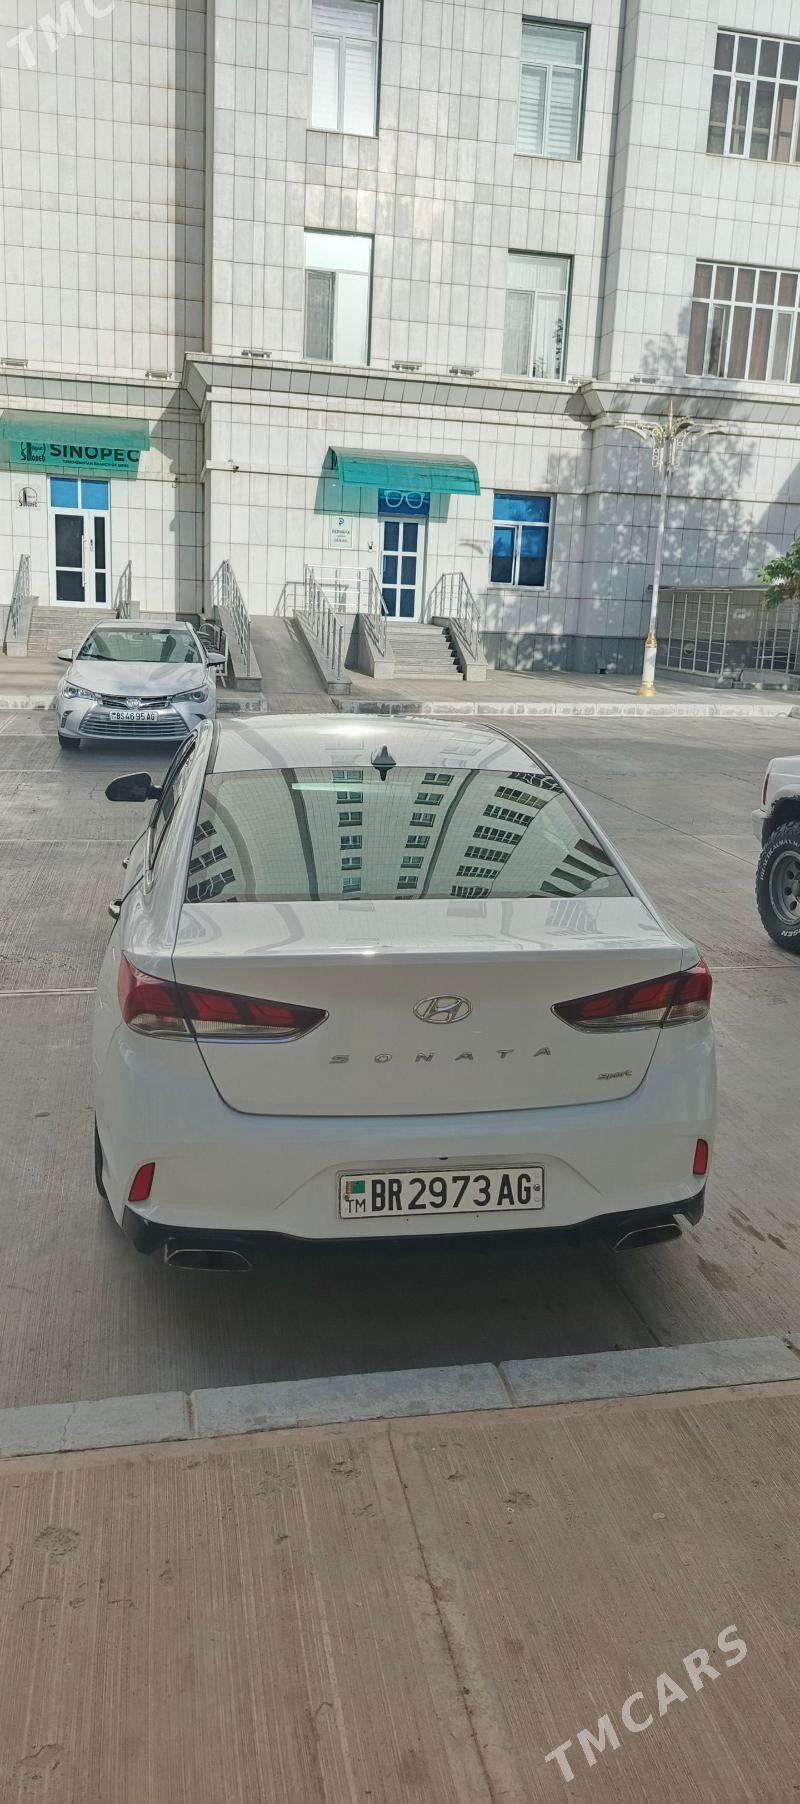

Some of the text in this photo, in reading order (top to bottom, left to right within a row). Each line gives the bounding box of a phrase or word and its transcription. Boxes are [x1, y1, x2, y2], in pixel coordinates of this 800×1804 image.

[50, 443, 140, 462] SINOPEC
[329, 1047, 552, 1064] SONATA
[348, 1198, 366, 1213] TM
